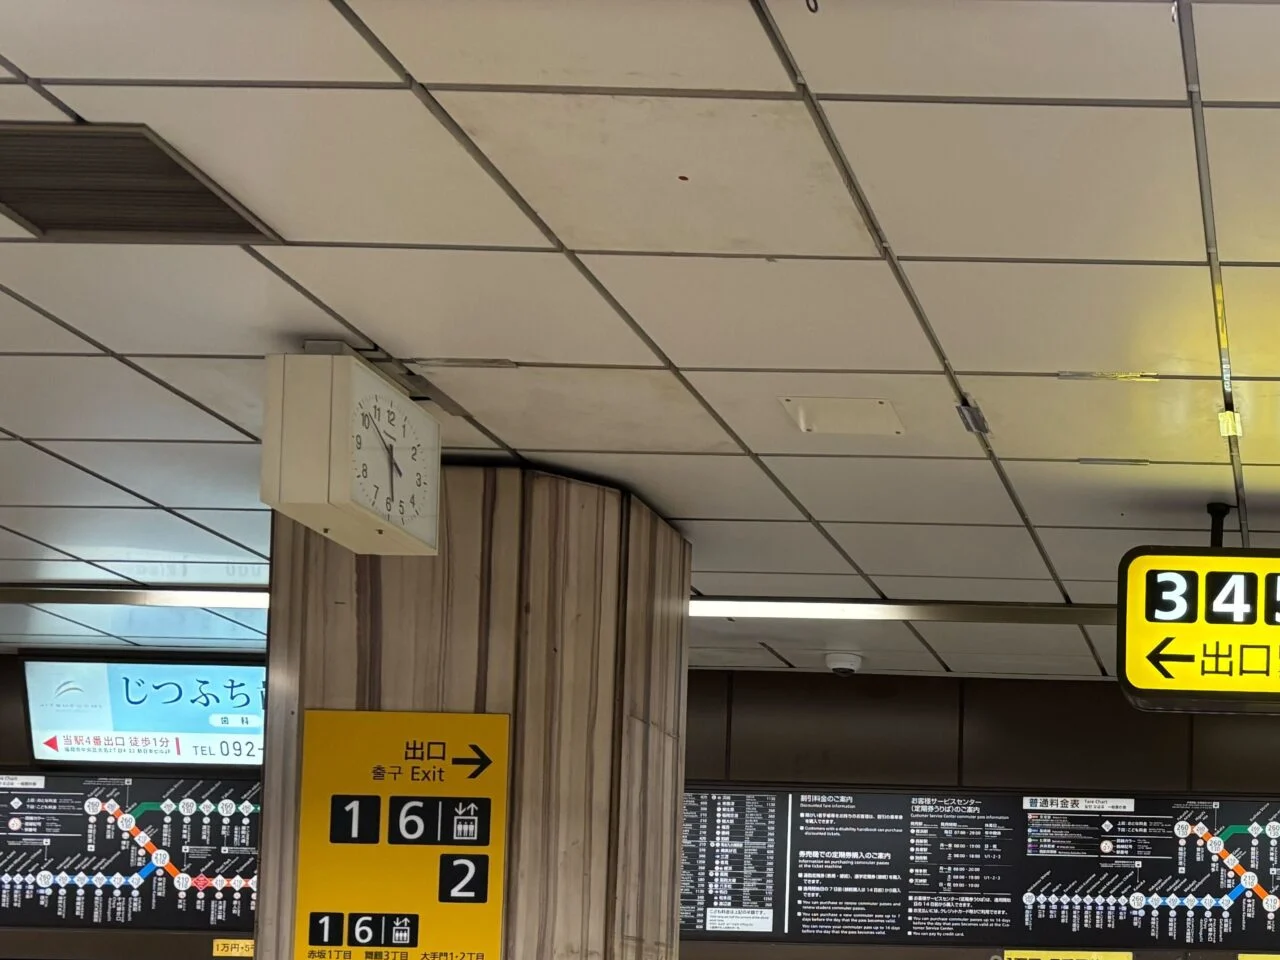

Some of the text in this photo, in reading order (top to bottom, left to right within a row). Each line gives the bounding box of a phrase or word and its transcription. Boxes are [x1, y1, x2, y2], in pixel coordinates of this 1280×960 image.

[361, 412, 370, 430] 10
[373, 405, 381, 422] 11
[387, 409, 396, 427] 12
[402, 423, 406, 438] 1
[356, 434, 362, 450] 9
[411, 446, 417, 461] 2
[362, 463, 368, 479] 8
[416, 472, 422, 487] 3
[373, 484, 379, 500] 7
[385, 496, 392, 512] 6
[399, 500, 405, 515] 5
[409, 494, 415, 508] 4
[1154, 572, 1187, 620] 3
[1212, 574, 1251, 623] 4
[1201, 641, 1271, 677] 出口
[63, 735, 170, 748] 当駅4番出口 徒歩1分
[193, 745, 216, 756] TEL
[404, 740, 446, 762] 出口
[371, 765, 404, 781] 출구
[411, 766, 445, 783] Exit
[1030, 798, 1080, 809] 普通料金表
[344, 800, 424, 839] 1 6
[450, 859, 476, 897] 2
[318, 916, 373, 943] 1 6
[308, 950, 352, 960] 赤坂1丁目
